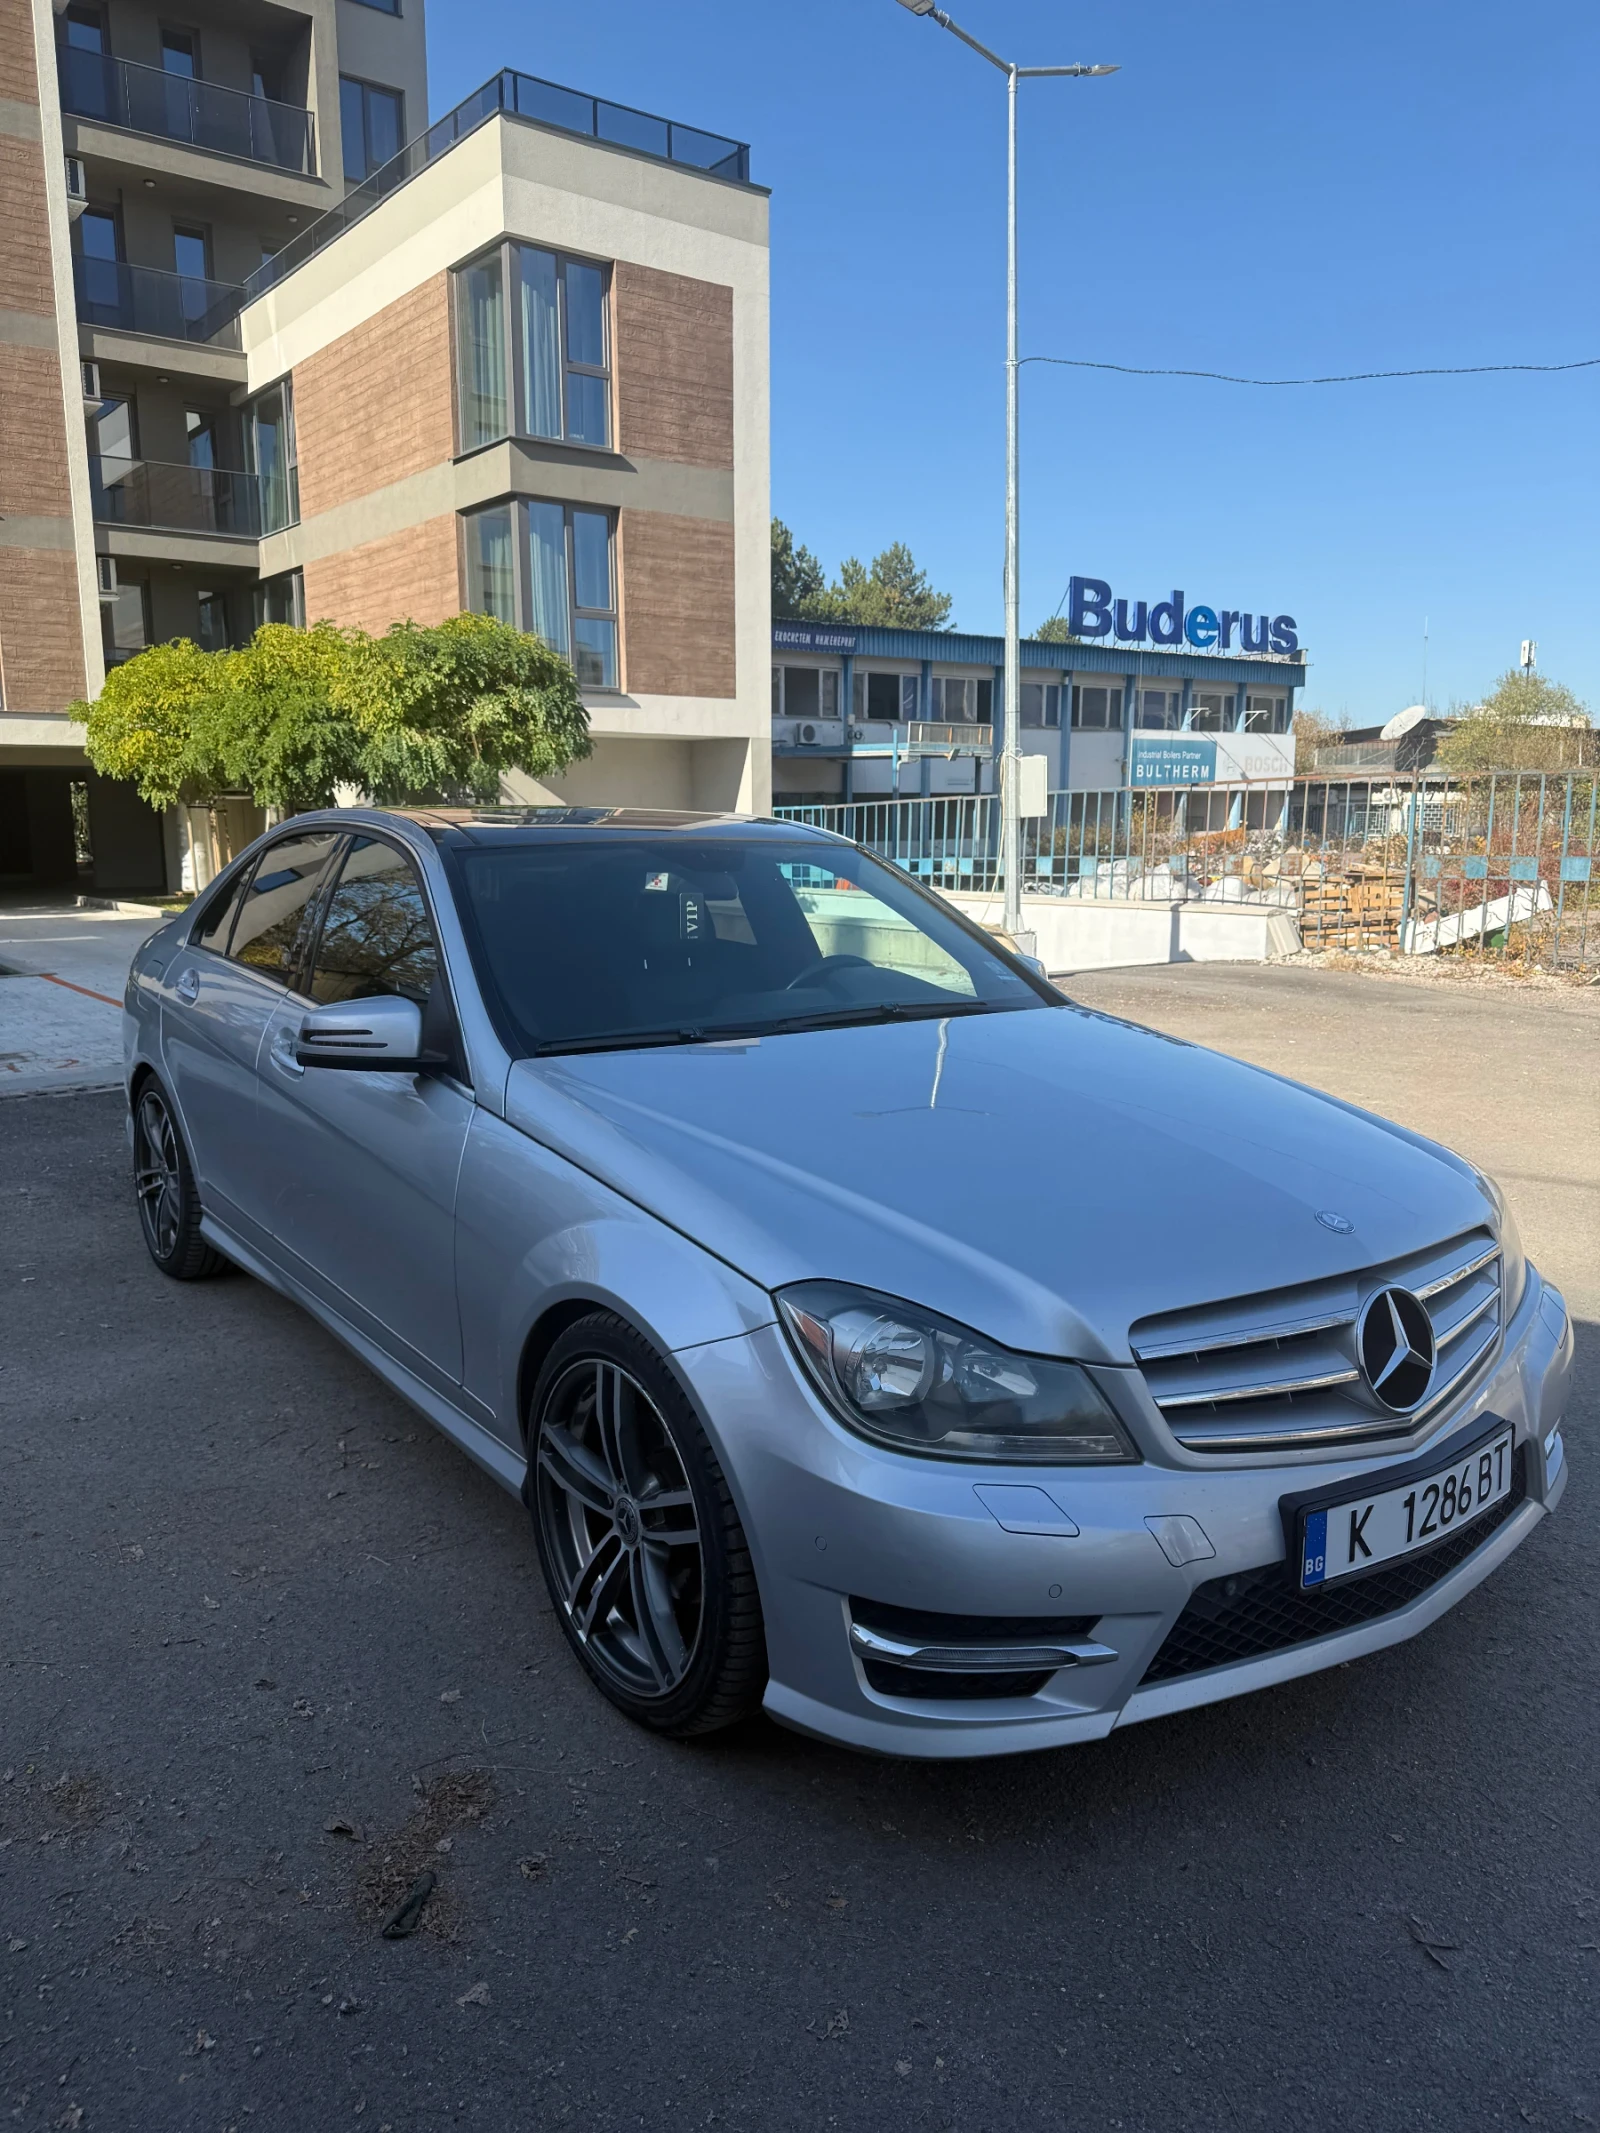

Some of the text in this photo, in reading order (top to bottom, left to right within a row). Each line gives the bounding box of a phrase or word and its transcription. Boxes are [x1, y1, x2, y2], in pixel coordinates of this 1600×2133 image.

[1068, 576, 1298, 655] Buderus
[1138, 750, 1202, 760] Industrial Boilers Partner
[1245, 755, 1288, 773] BOSCH
[1136, 764, 1210, 779] BULTHERM
[686, 901, 698, 933] VIP
[1348, 1504, 1375, 1562] K
[1305, 1555, 1324, 1576] BG
